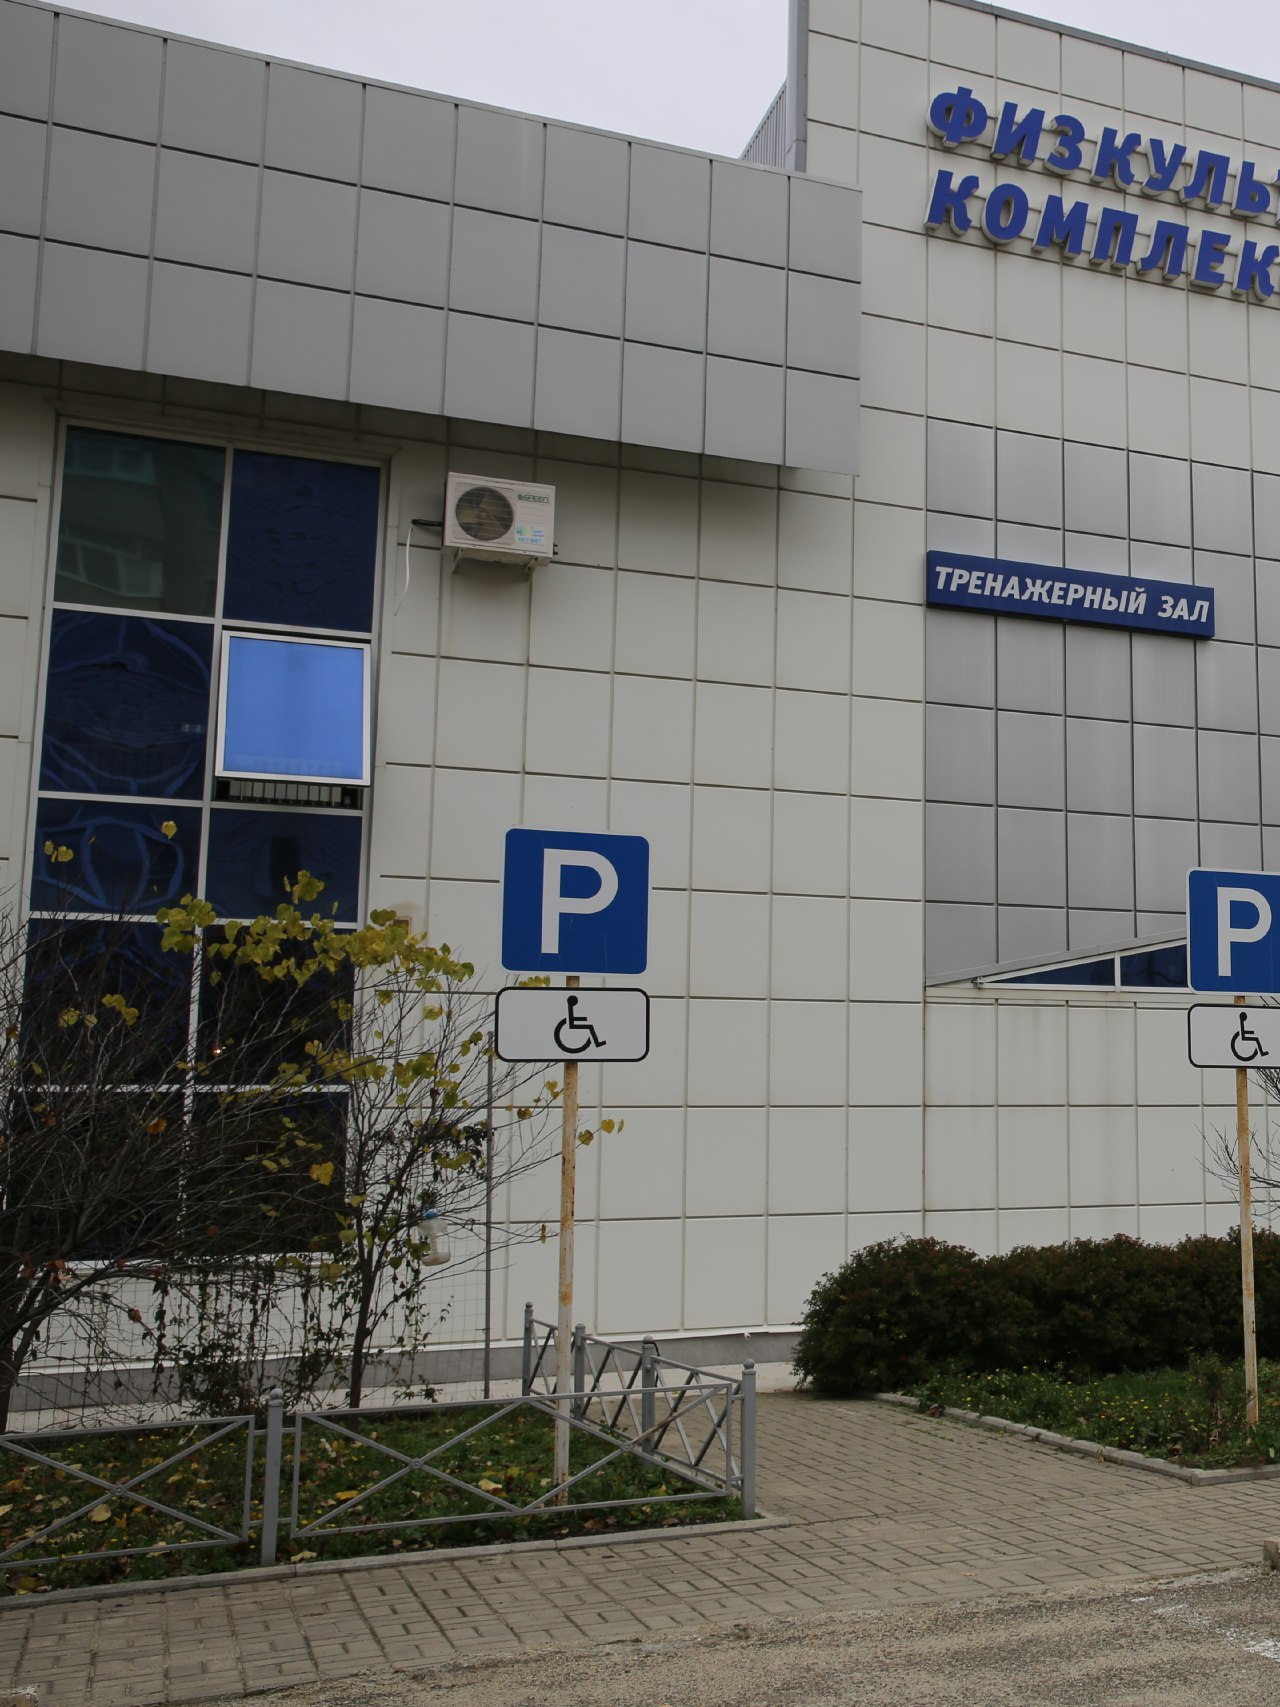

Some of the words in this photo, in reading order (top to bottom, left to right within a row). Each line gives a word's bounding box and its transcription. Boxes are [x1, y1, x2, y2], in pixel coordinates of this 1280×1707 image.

[935, 566, 1147, 615] ТРЕНАЖЕРНЫЙ
[1157, 595, 1210, 623] ЗАЛ
[541, 848, 619, 954] P
[1217, 886, 1272, 977] P
